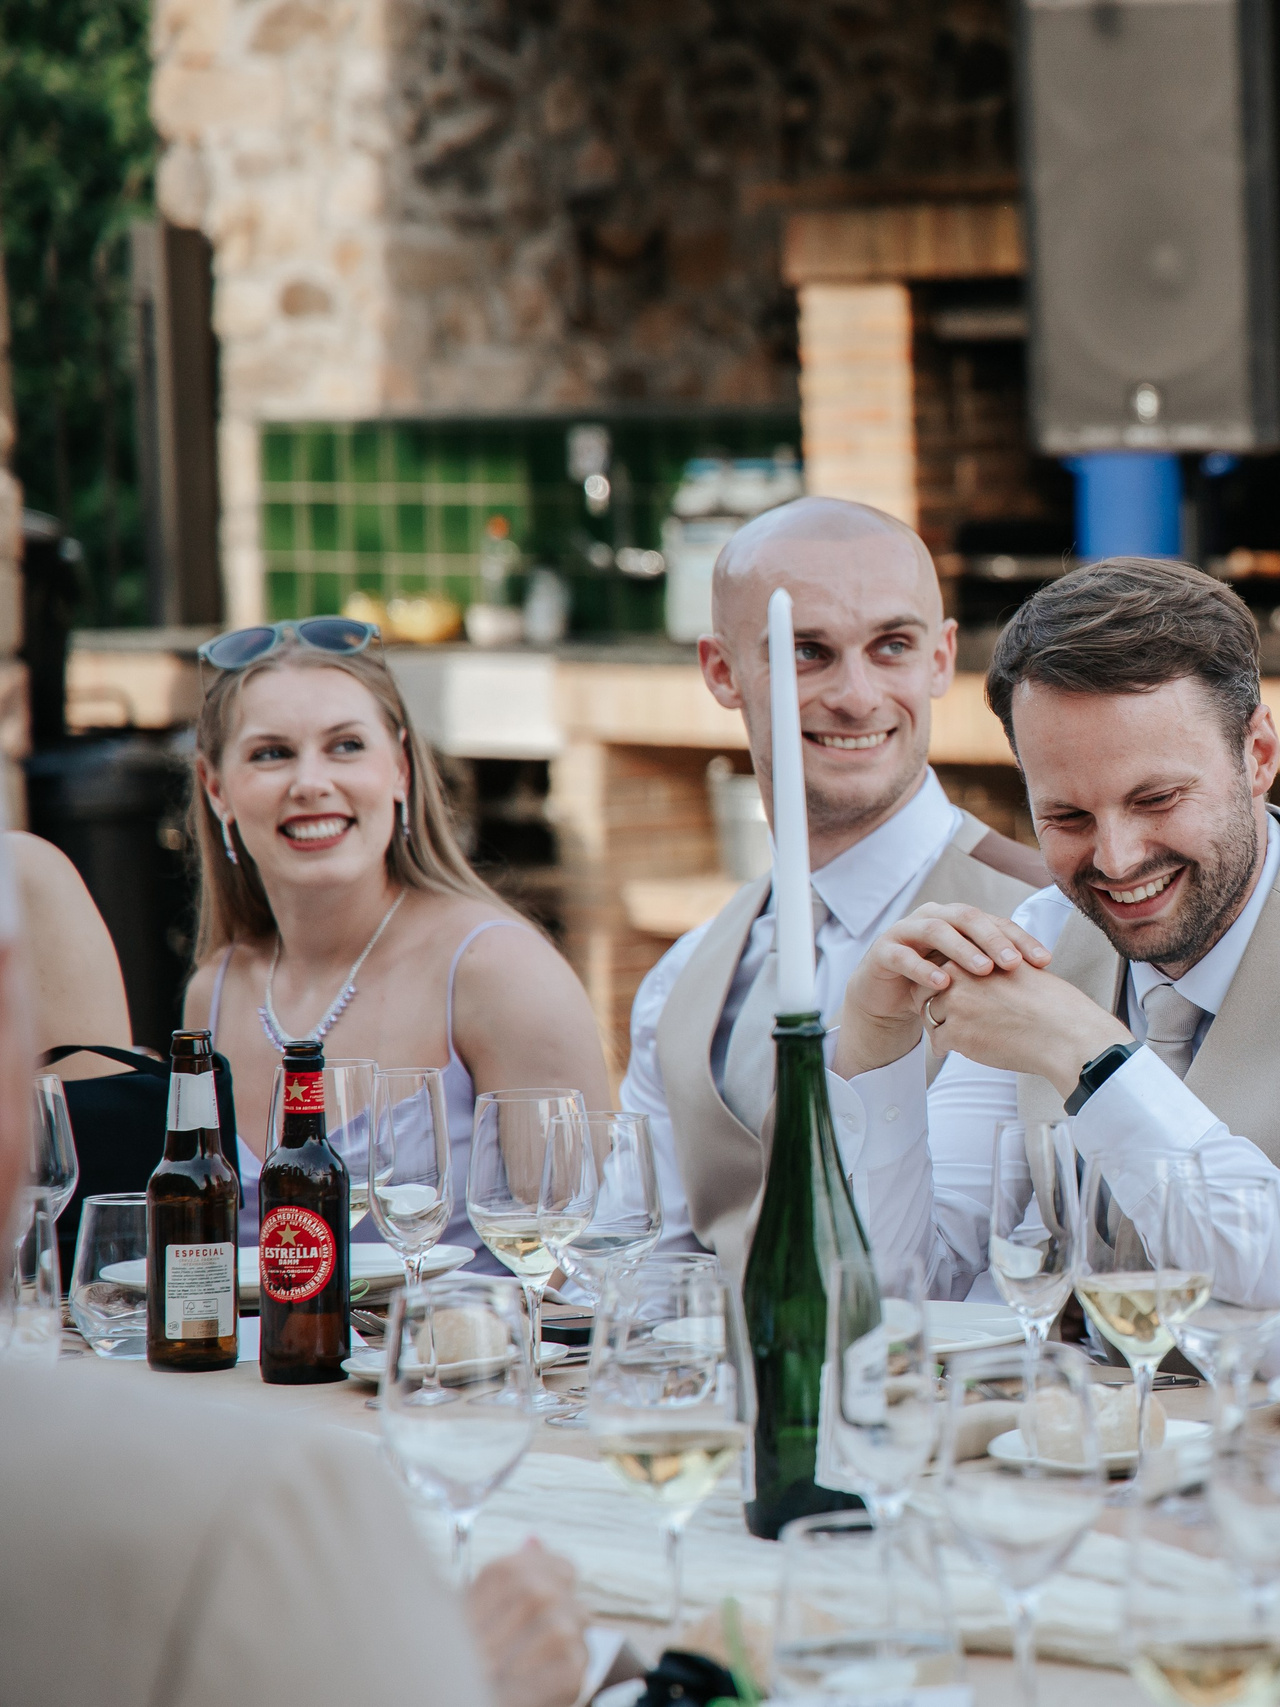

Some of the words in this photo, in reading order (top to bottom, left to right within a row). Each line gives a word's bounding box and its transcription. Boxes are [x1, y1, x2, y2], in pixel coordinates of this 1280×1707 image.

[175, 1248, 224, 1258] ESPECIAL
[265, 1247, 318, 1259] ESTRELLA
[314, 1260, 329, 1282] DAMM
